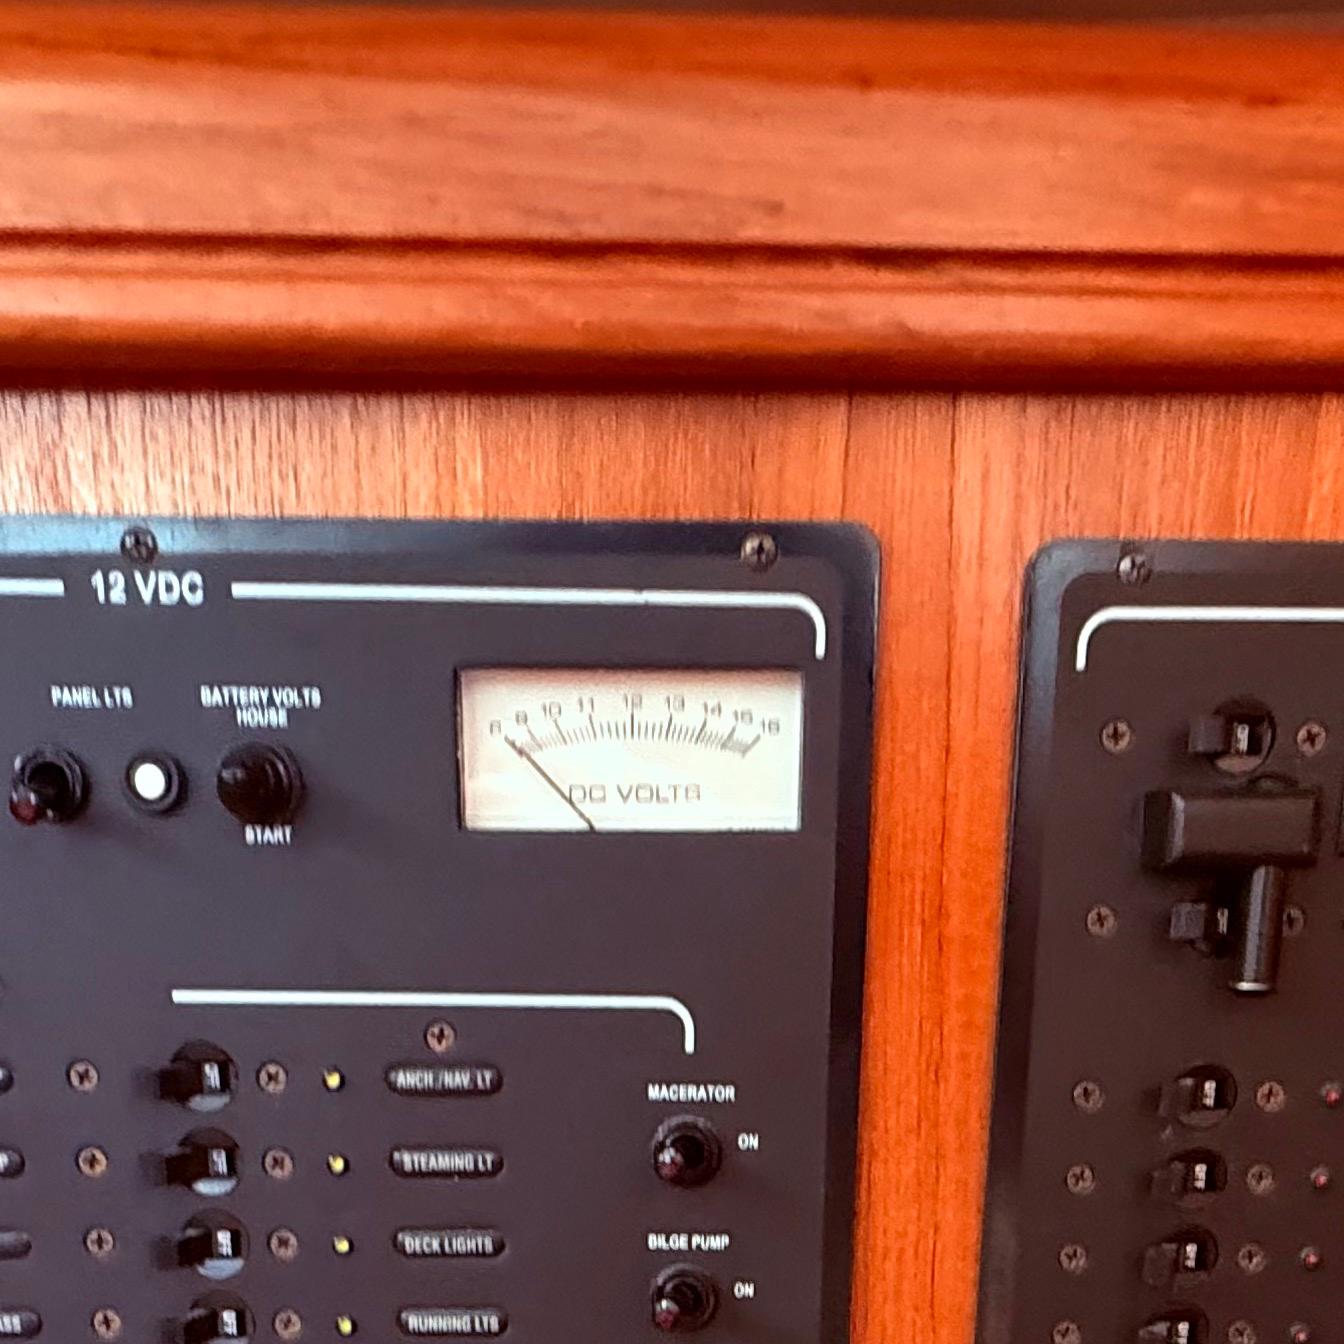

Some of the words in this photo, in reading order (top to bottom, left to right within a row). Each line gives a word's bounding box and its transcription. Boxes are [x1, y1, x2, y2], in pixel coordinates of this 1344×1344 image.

[91, 569, 126, 605] 12
[133, 570, 204, 606] VDC
[51, 685, 102, 708] PANEL
[104, 686, 134, 709] LTS
[200, 685, 269, 708] BATTERY
[272, 686, 321, 709] VOLTS
[578, 696, 595, 713] 11
[623, 693, 643, 710] 12
[665, 694, 685, 712] 13
[236, 706, 288, 728] HOUSE
[541, 702, 562, 718] 10
[702, 700, 722, 717] 14
[732, 709, 753, 725] 15
[761, 718, 780, 735] 16
[569, 784, 607, 804] DC
[616, 783, 702, 804] VOLTS
[245, 824, 292, 845] START
[476, 1069, 492, 1090] LT
[648, 1084, 735, 1102] MACERATOR
[738, 1134, 758, 1150] ON
[402, 1150, 473, 1172] STEAMING
[476, 1150, 494, 1172] LT
[404, 1236, 442, 1255] DECK
[444, 1236, 494, 1255] LIGHTS
[648, 1234, 689, 1250] BILGE
[691, 1234, 730, 1250] PUMP
[734, 1282, 755, 1298] ON
[408, 1314, 471, 1333] RUNNING
[474, 1314, 499, 1333] LTS
